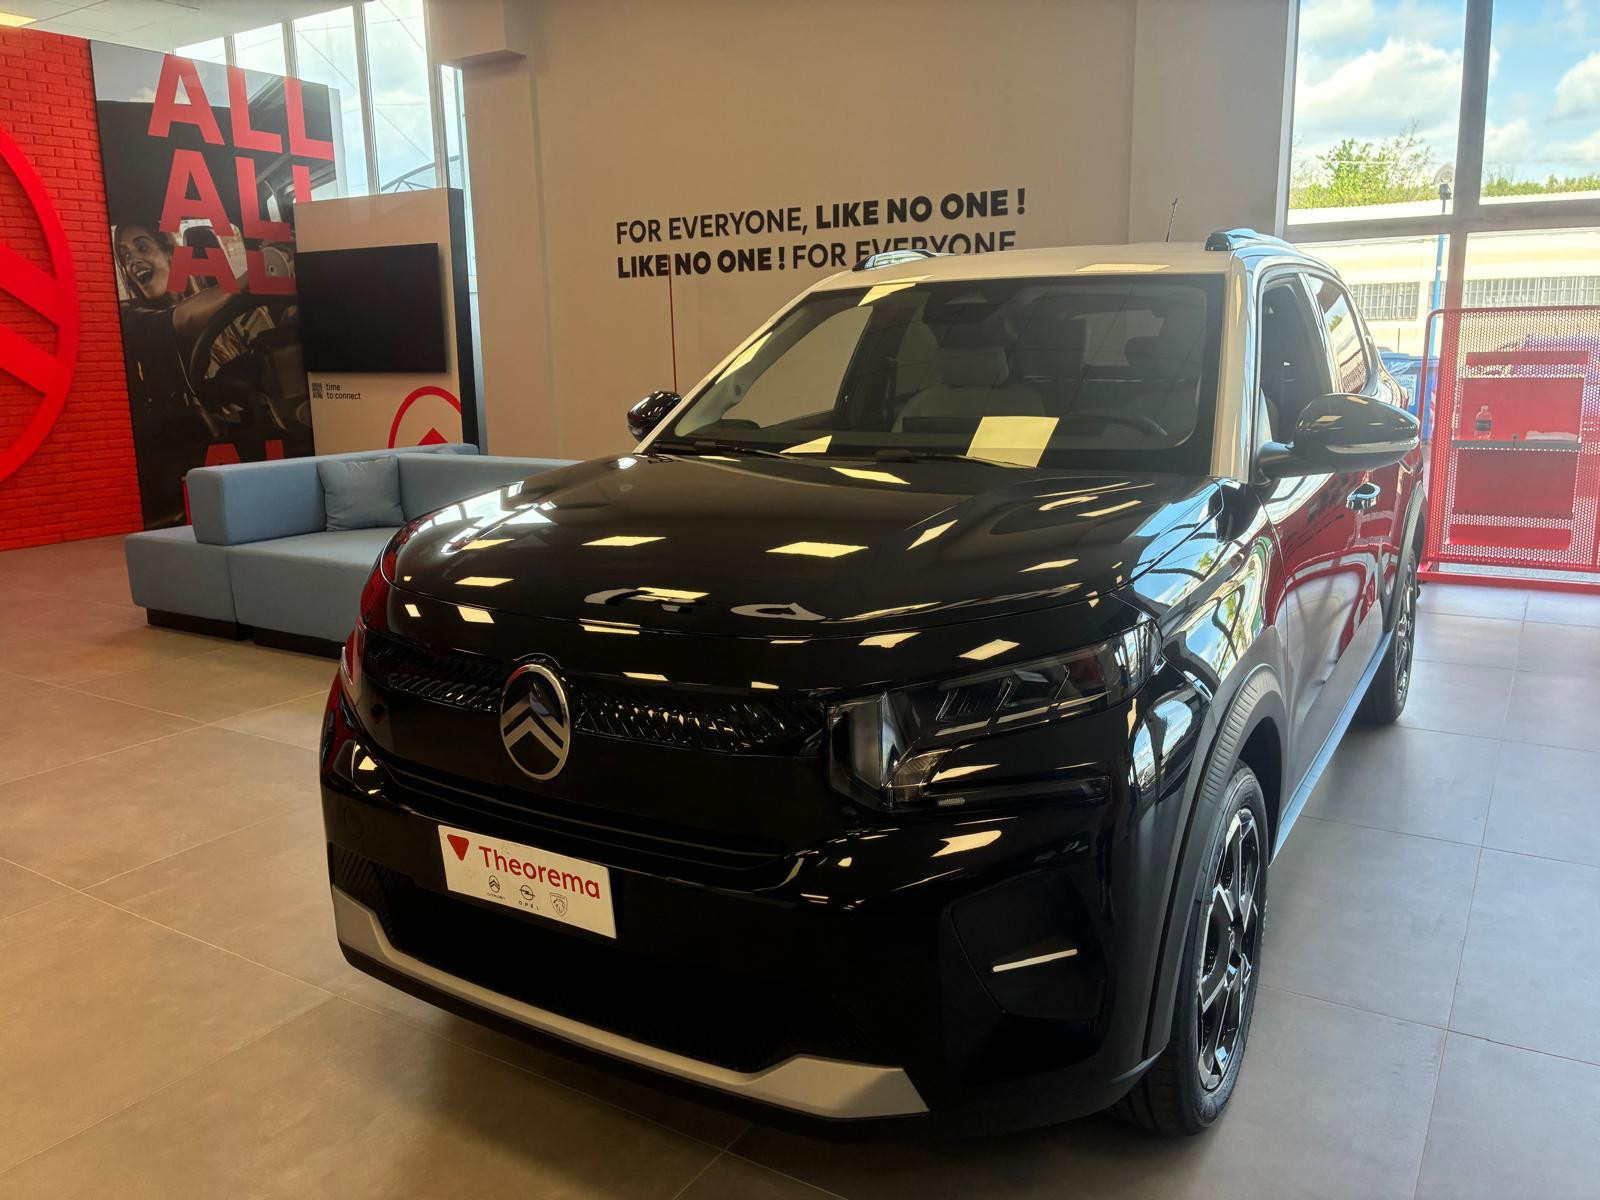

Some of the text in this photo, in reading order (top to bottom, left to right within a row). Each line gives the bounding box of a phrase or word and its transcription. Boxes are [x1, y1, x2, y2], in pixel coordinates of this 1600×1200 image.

[148, 54, 334, 161] ALL
[616, 218, 662, 245] FOR
[669, 206, 809, 241] EVERYONE,
[816, 200, 879, 230] LIKE
[887, 195, 933, 224] NO
[940, 189, 1009, 220] ONE
[617, 254, 670, 279] LIKE
[674, 251, 712, 277] NO
[717, 247, 772, 273] ONE
[792, 242, 847, 270] FOR
[479, 845, 601, 899] Theorema
[519, 900, 540, 910] OPEL
